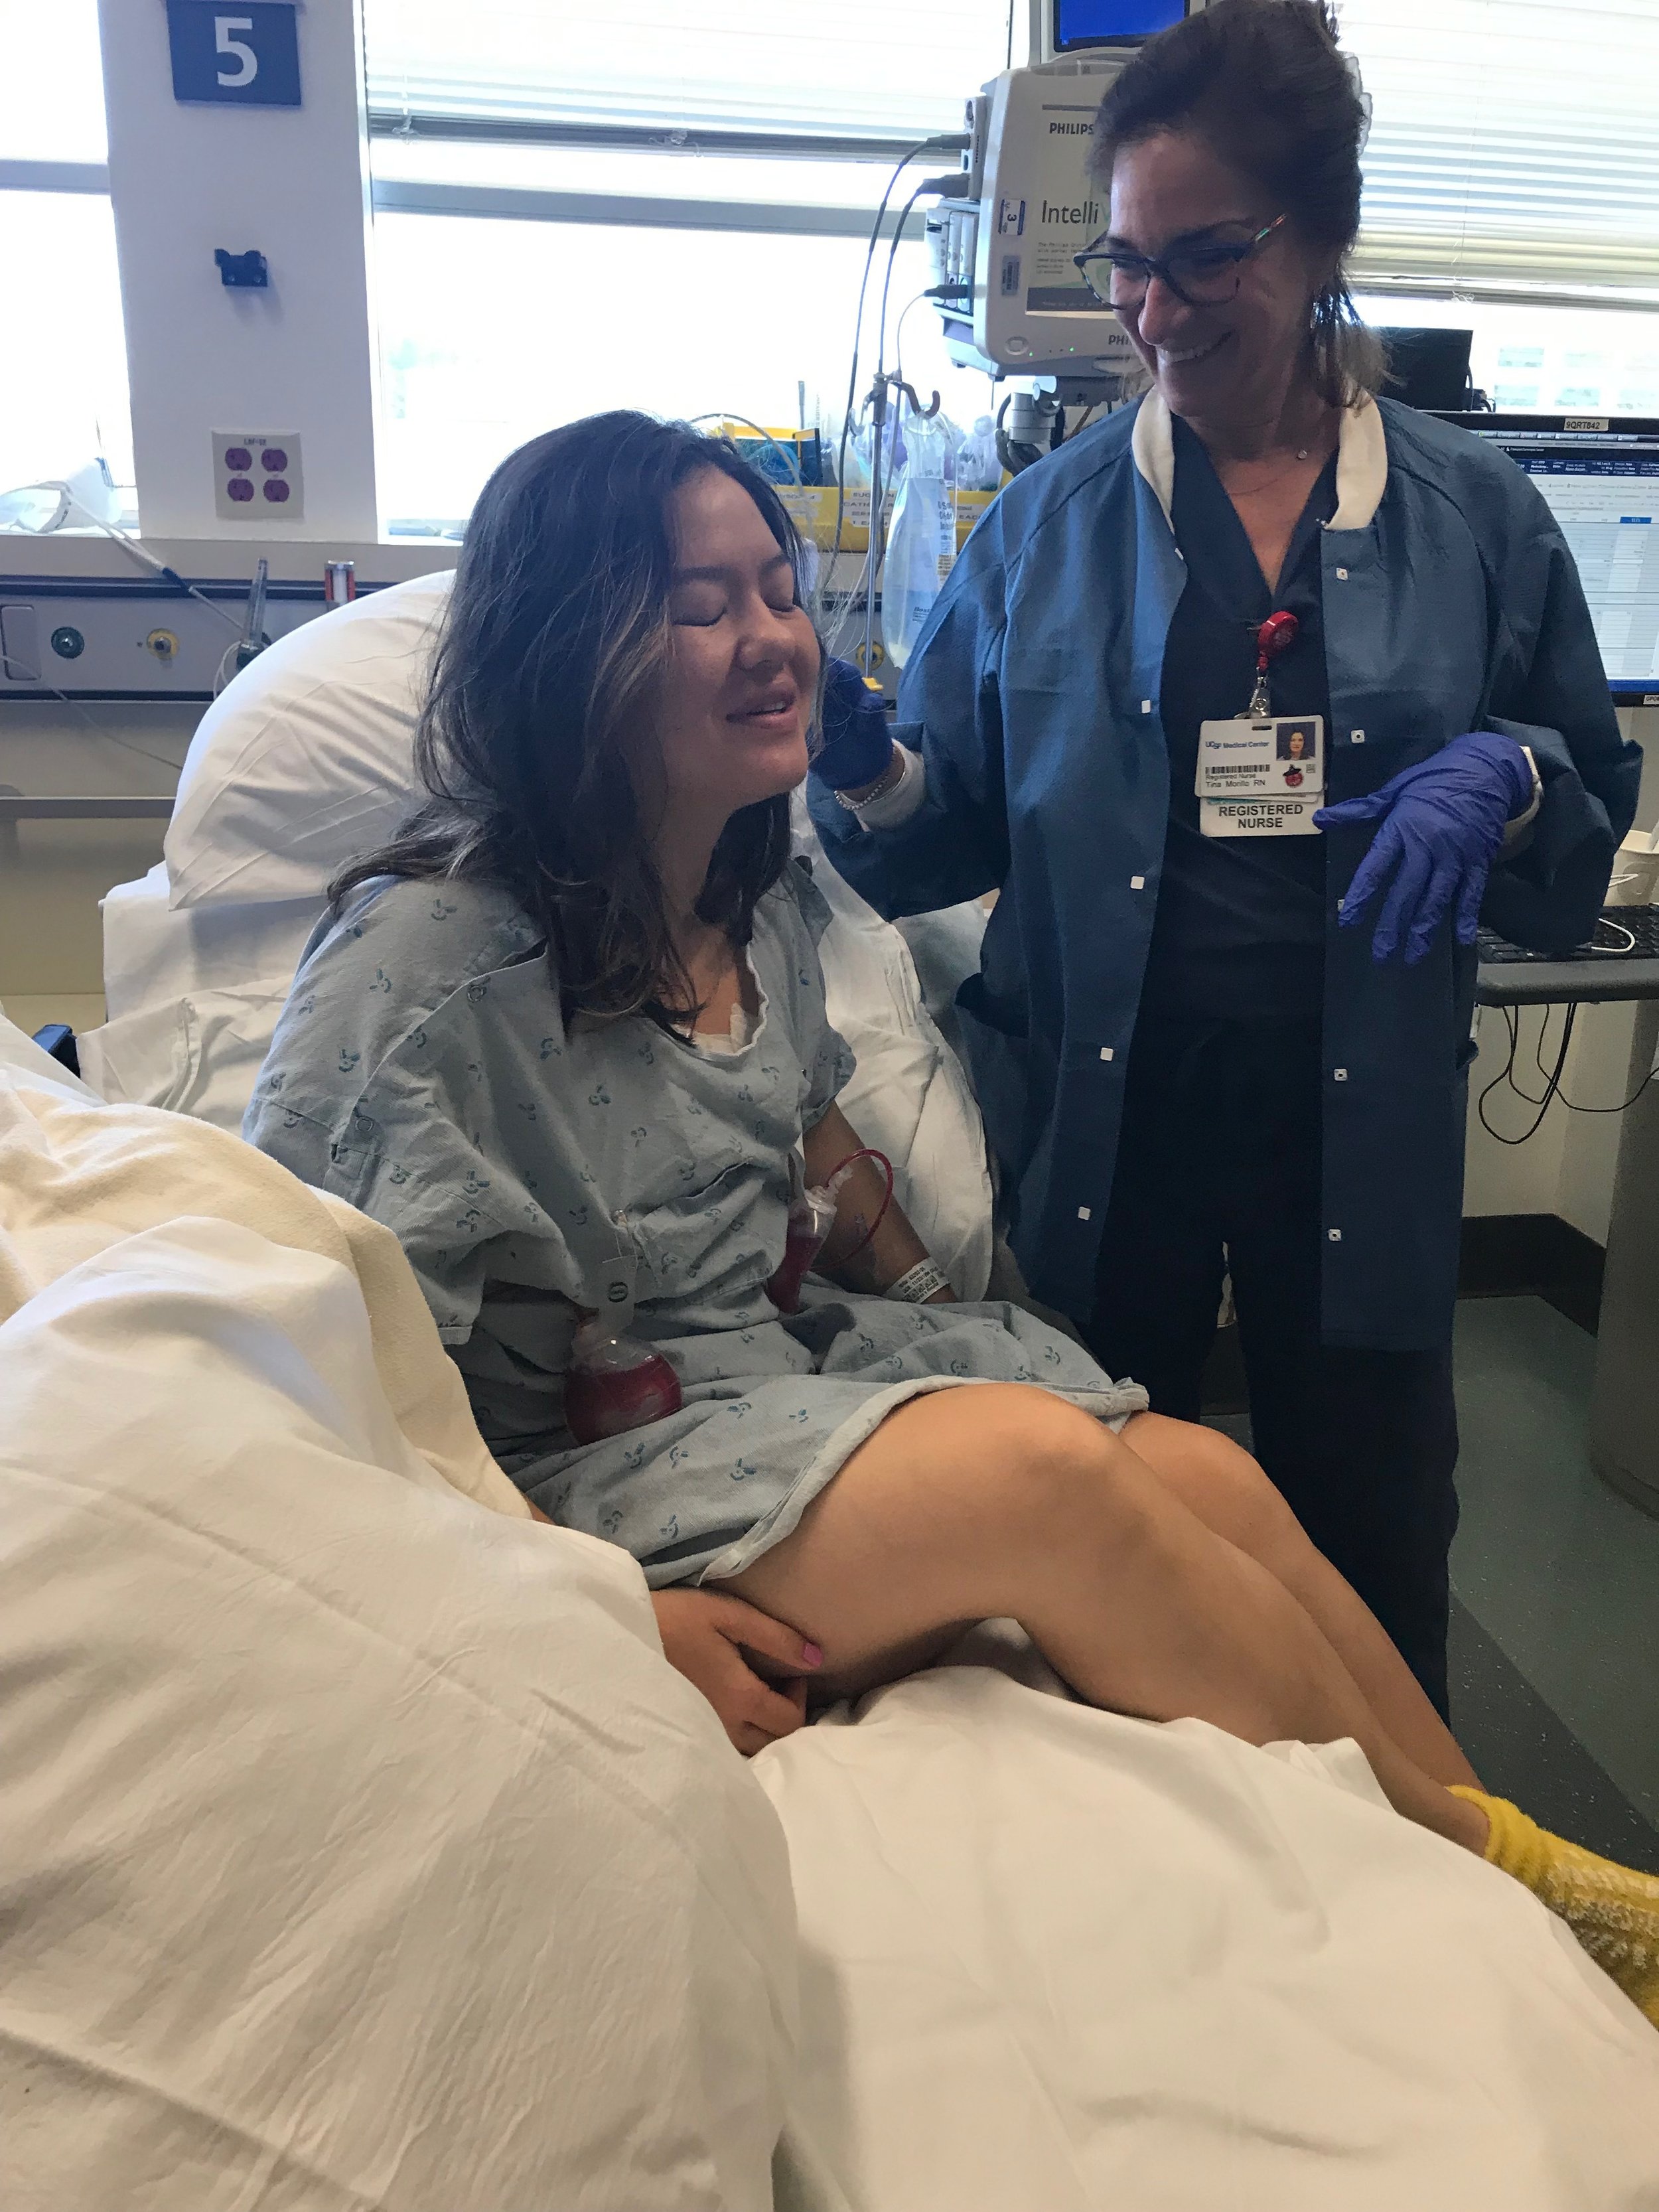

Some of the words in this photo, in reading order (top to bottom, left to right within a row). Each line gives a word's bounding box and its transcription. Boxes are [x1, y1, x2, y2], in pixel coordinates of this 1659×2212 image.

[215, 17, 257, 87] 5
[1049, 122, 1094, 135] PHILIPS
[1218, 804, 1303, 816] REGISTERED
[1238, 818, 1283, 829] NURSE
